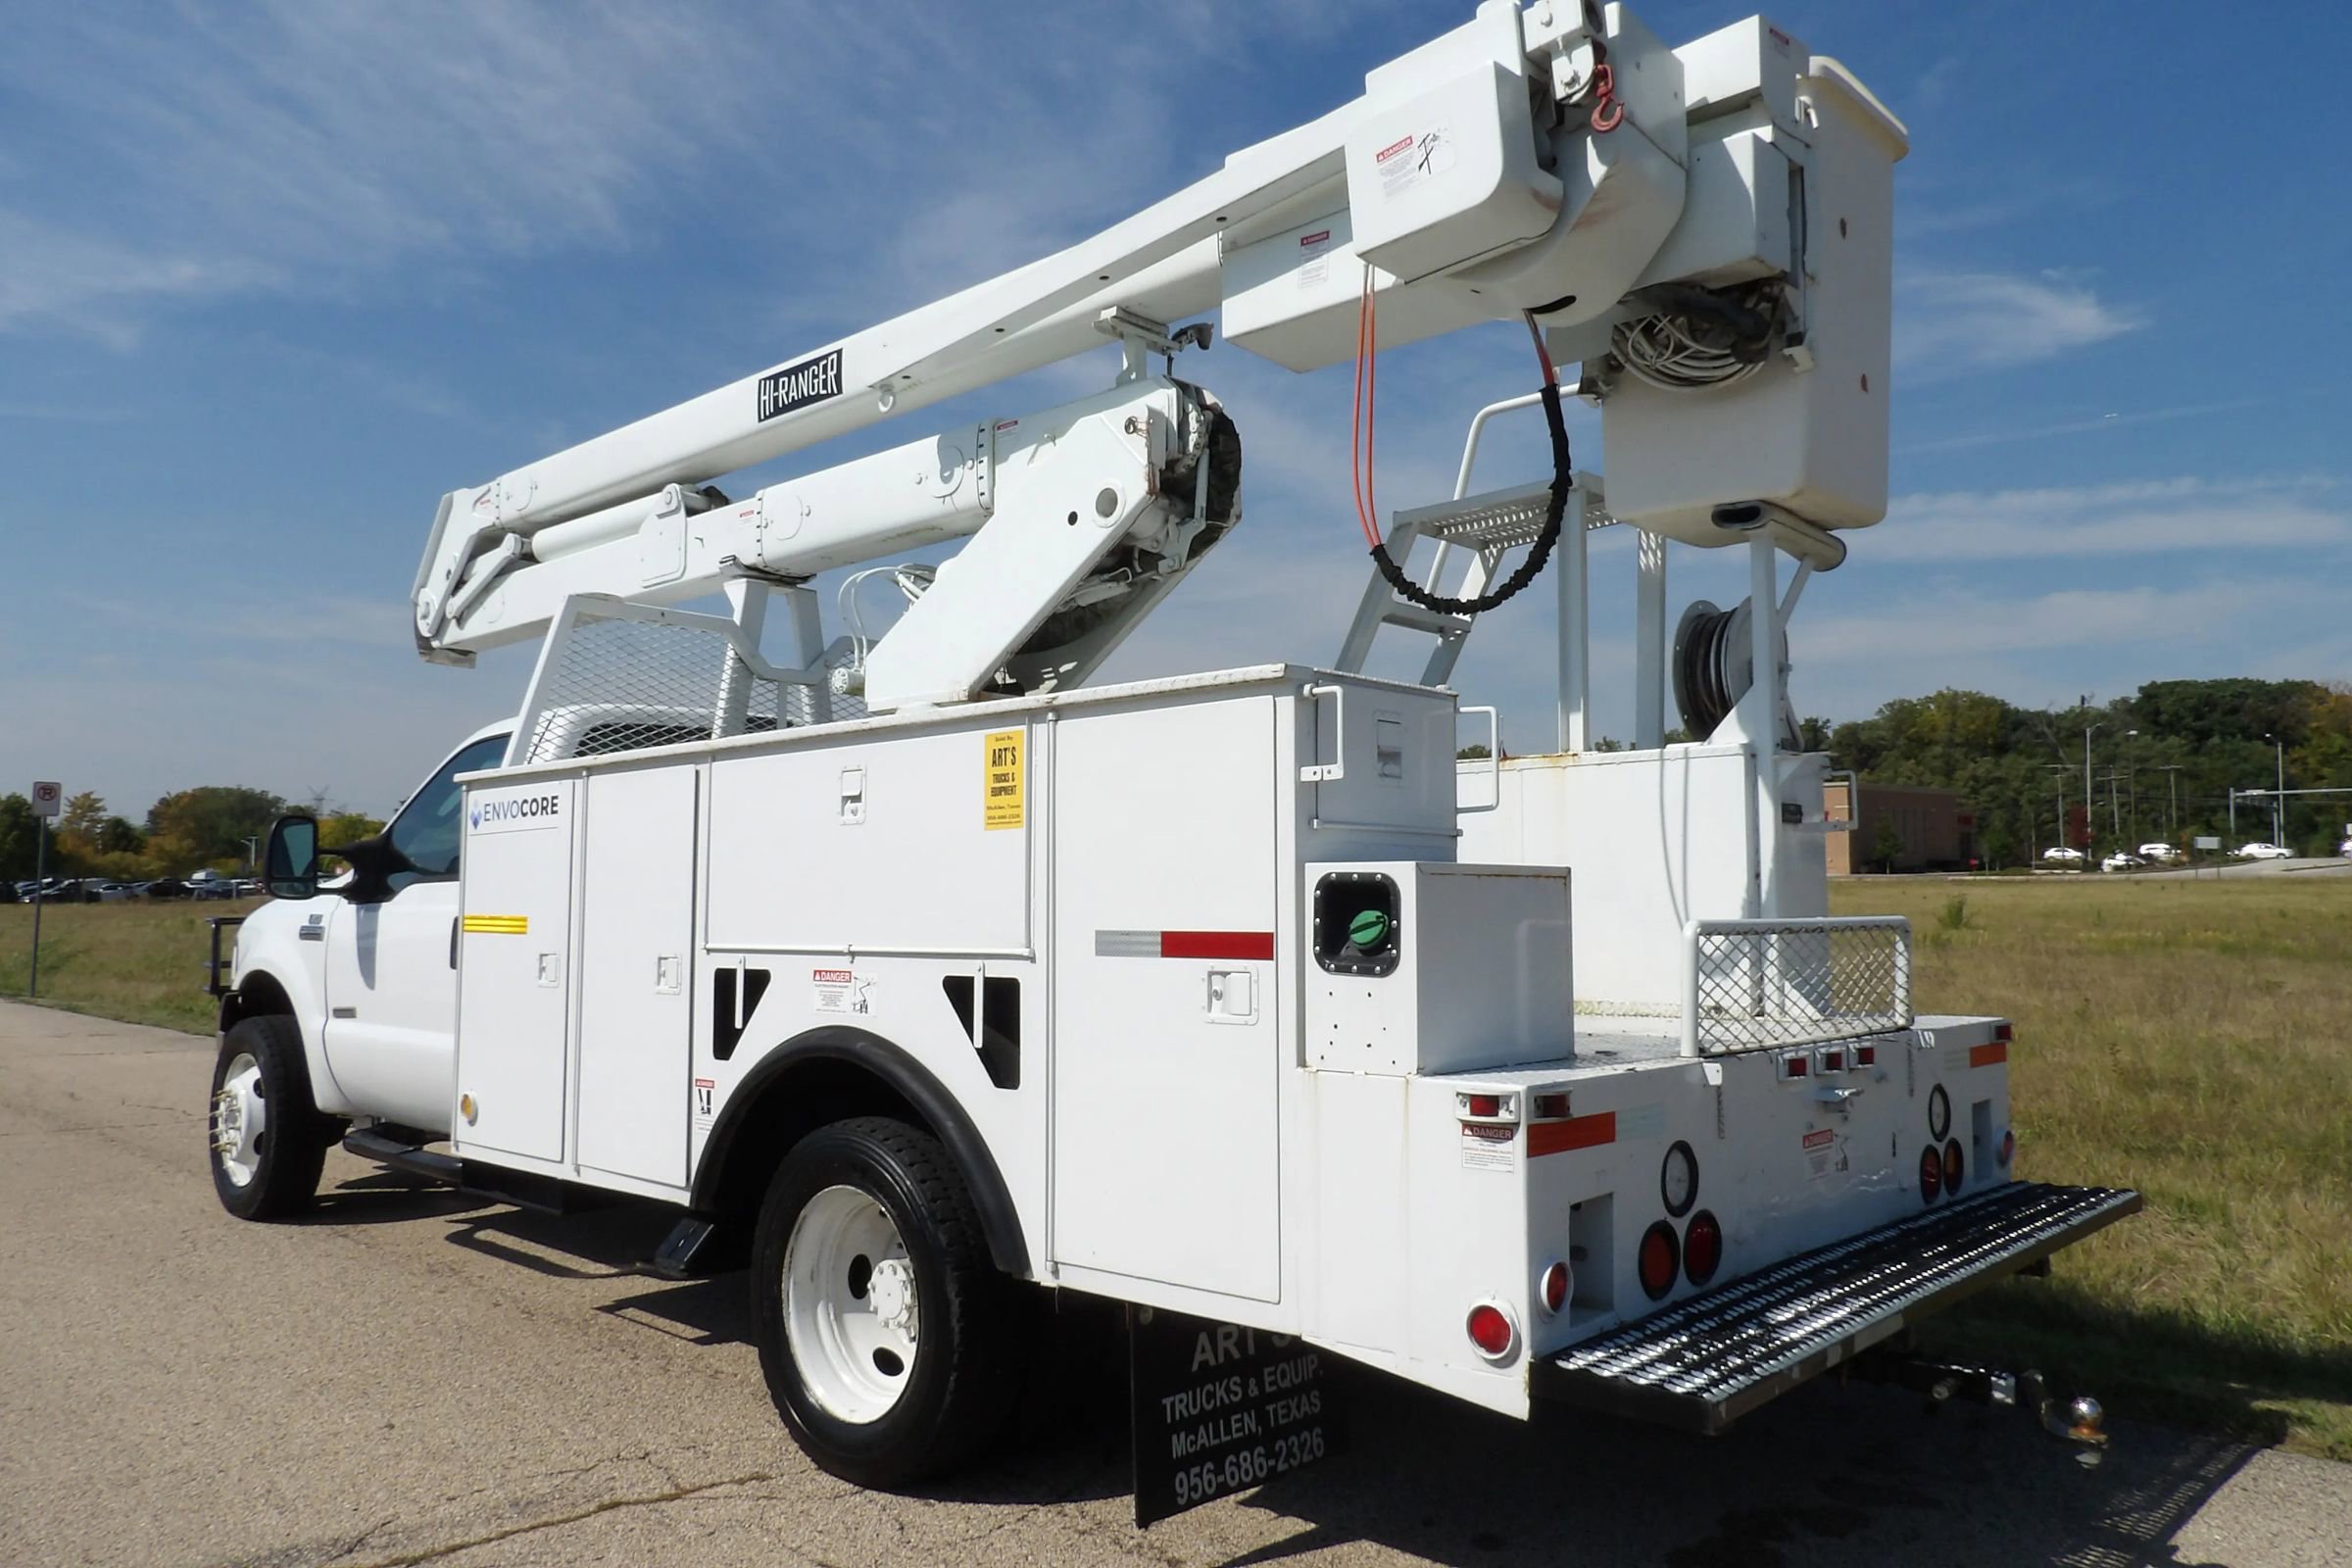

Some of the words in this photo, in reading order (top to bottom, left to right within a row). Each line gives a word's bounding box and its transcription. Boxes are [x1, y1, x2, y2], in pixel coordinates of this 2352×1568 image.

[1383, 137, 1411, 157] DANGER
[760, 352, 838, 420] HI-RANGER
[992, 746, 1016, 767] ART'S
[992, 772, 1010, 784] TRUCKS
[991, 785, 1017, 797] EQUIPMENT
[483, 795, 560, 822] ENVOCORE
[820, 971, 851, 982] DANGER
[1473, 1127, 1511, 1139] DANGER
[1161, 1376, 1243, 1424] TRUCKS
[1248, 1377, 1259, 1397] &
[1262, 1353, 1324, 1394] EQUIP.
[1171, 1408, 1262, 1459] McALLEN,
[1265, 1390, 1321, 1428] TEXAS
[1175, 1426, 1324, 1505] 956-686-2326
